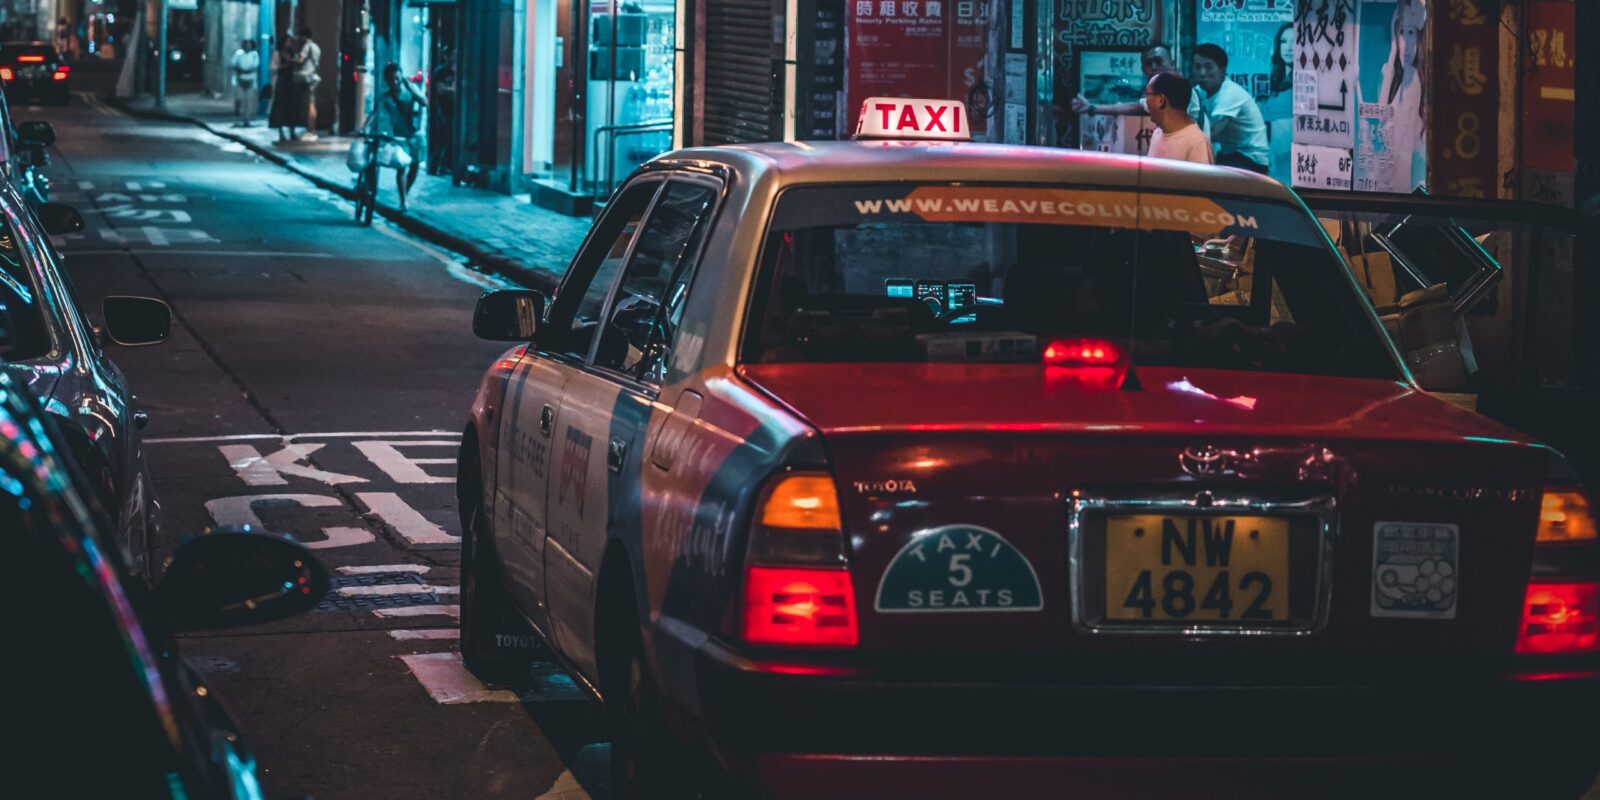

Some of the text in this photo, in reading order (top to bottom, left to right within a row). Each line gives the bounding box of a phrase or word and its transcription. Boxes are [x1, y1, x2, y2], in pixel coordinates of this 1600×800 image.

[856, 1, 941, 16] 時租收費
[876, 104, 960, 132] TAXI
[855, 198, 1258, 229] WWW.WEAVECOLIVING.COM
[217, 440, 459, 486] KE
[854, 480, 917, 493] TOYOTA
[910, 533, 1002, 562] TAXI
[1161, 518, 1236, 567] NW
[948, 553, 973, 587] 5
[908, 589, 1013, 607] SEATS
[1122, 569, 1274, 619] 4842
